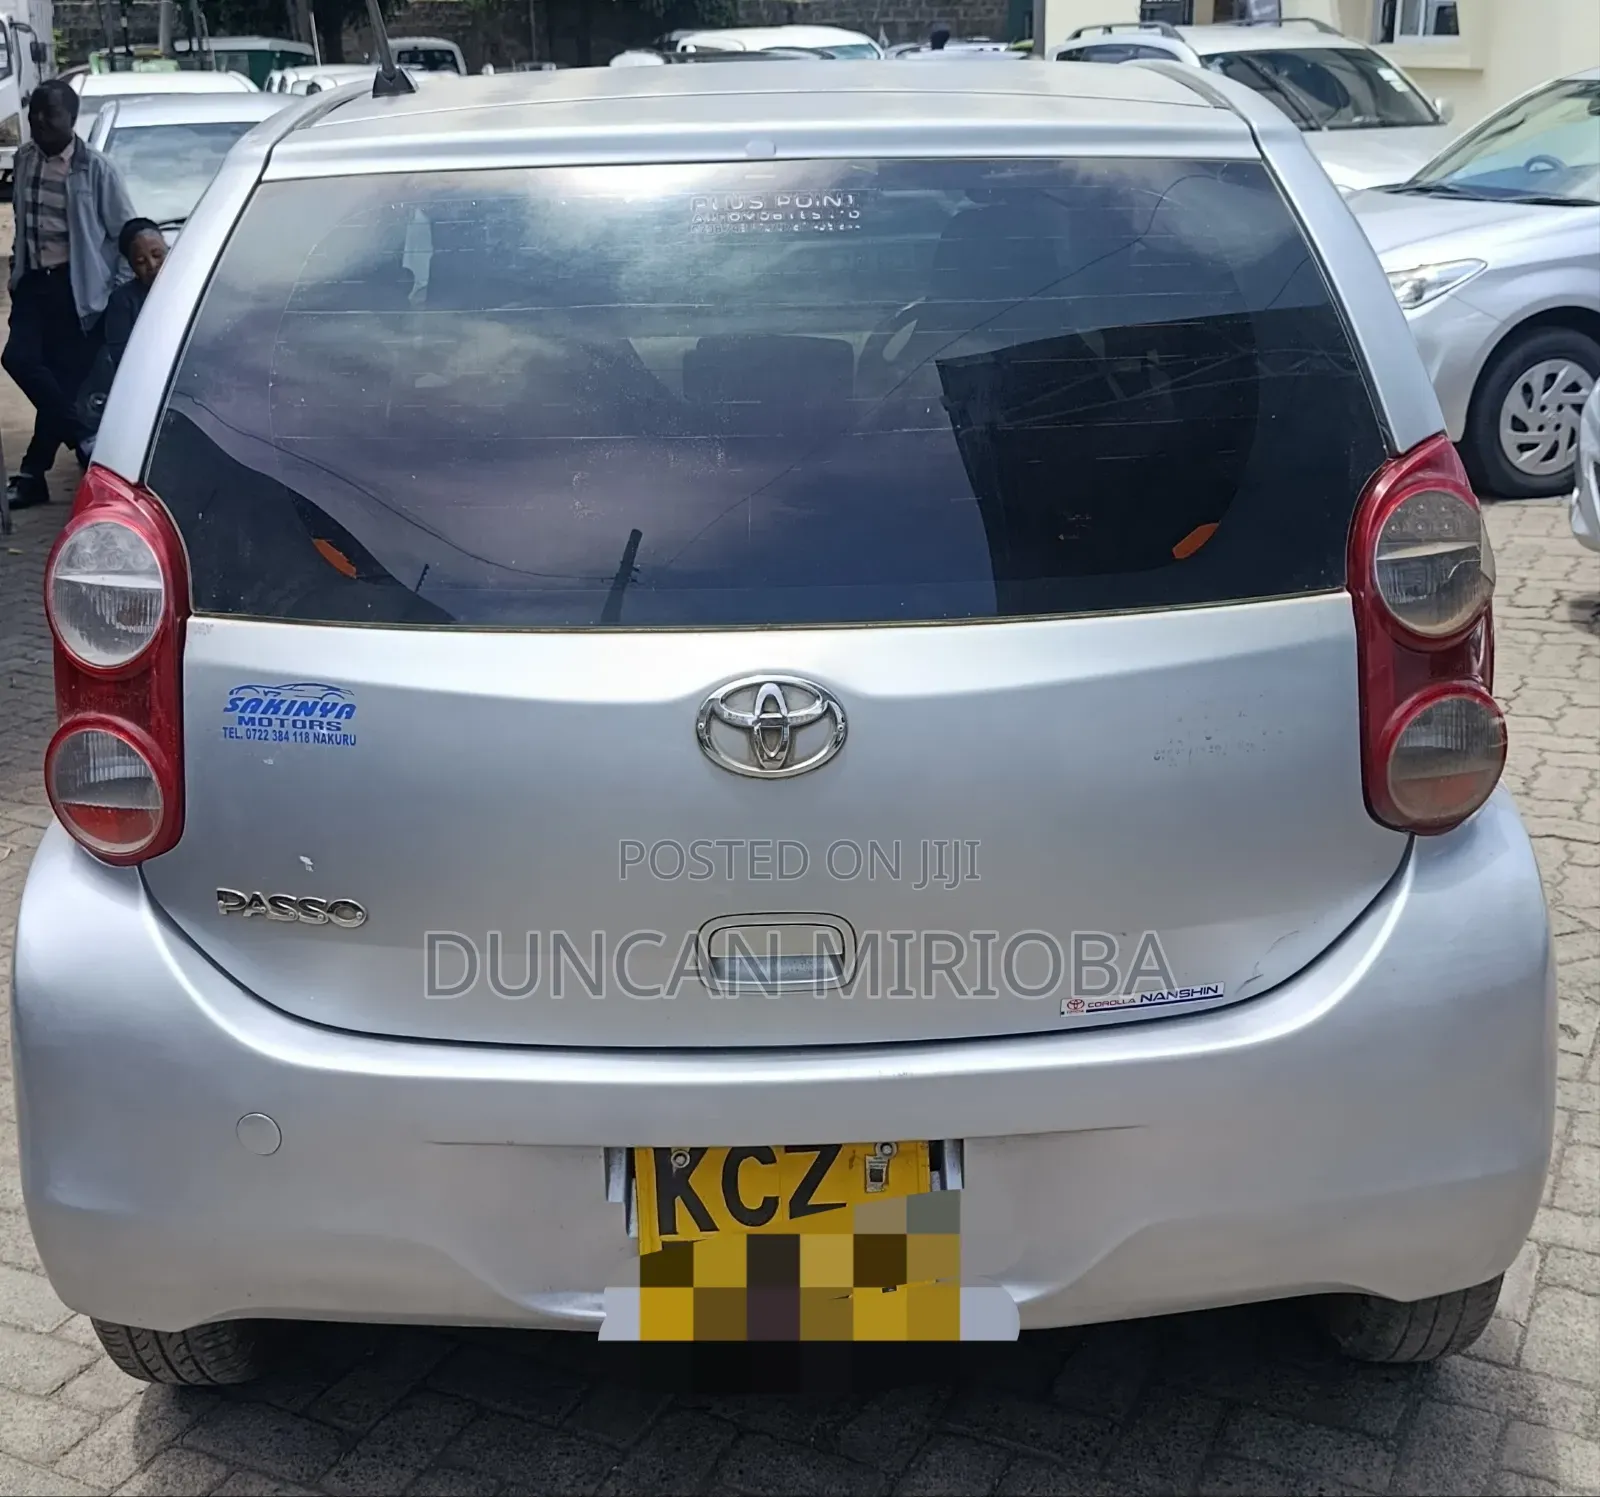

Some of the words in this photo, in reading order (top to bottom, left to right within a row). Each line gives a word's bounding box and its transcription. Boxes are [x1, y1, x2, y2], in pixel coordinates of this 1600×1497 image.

[223, 697, 357, 719] SAKINYA
[237, 715, 342, 731] MOTORS
[222, 726, 243, 739] TEL.
[245, 728, 269, 741] 0722
[272, 730, 290, 742] 384
[293, 731, 310, 743] 118
[313, 732, 357, 746] NAKURU
[216, 887, 366, 928] PASSO
[1087, 998, 1136, 1009] COROLLA
[1140, 985, 1219, 1003] NANSHIN
[653, 1144, 847, 1235] KCZ
